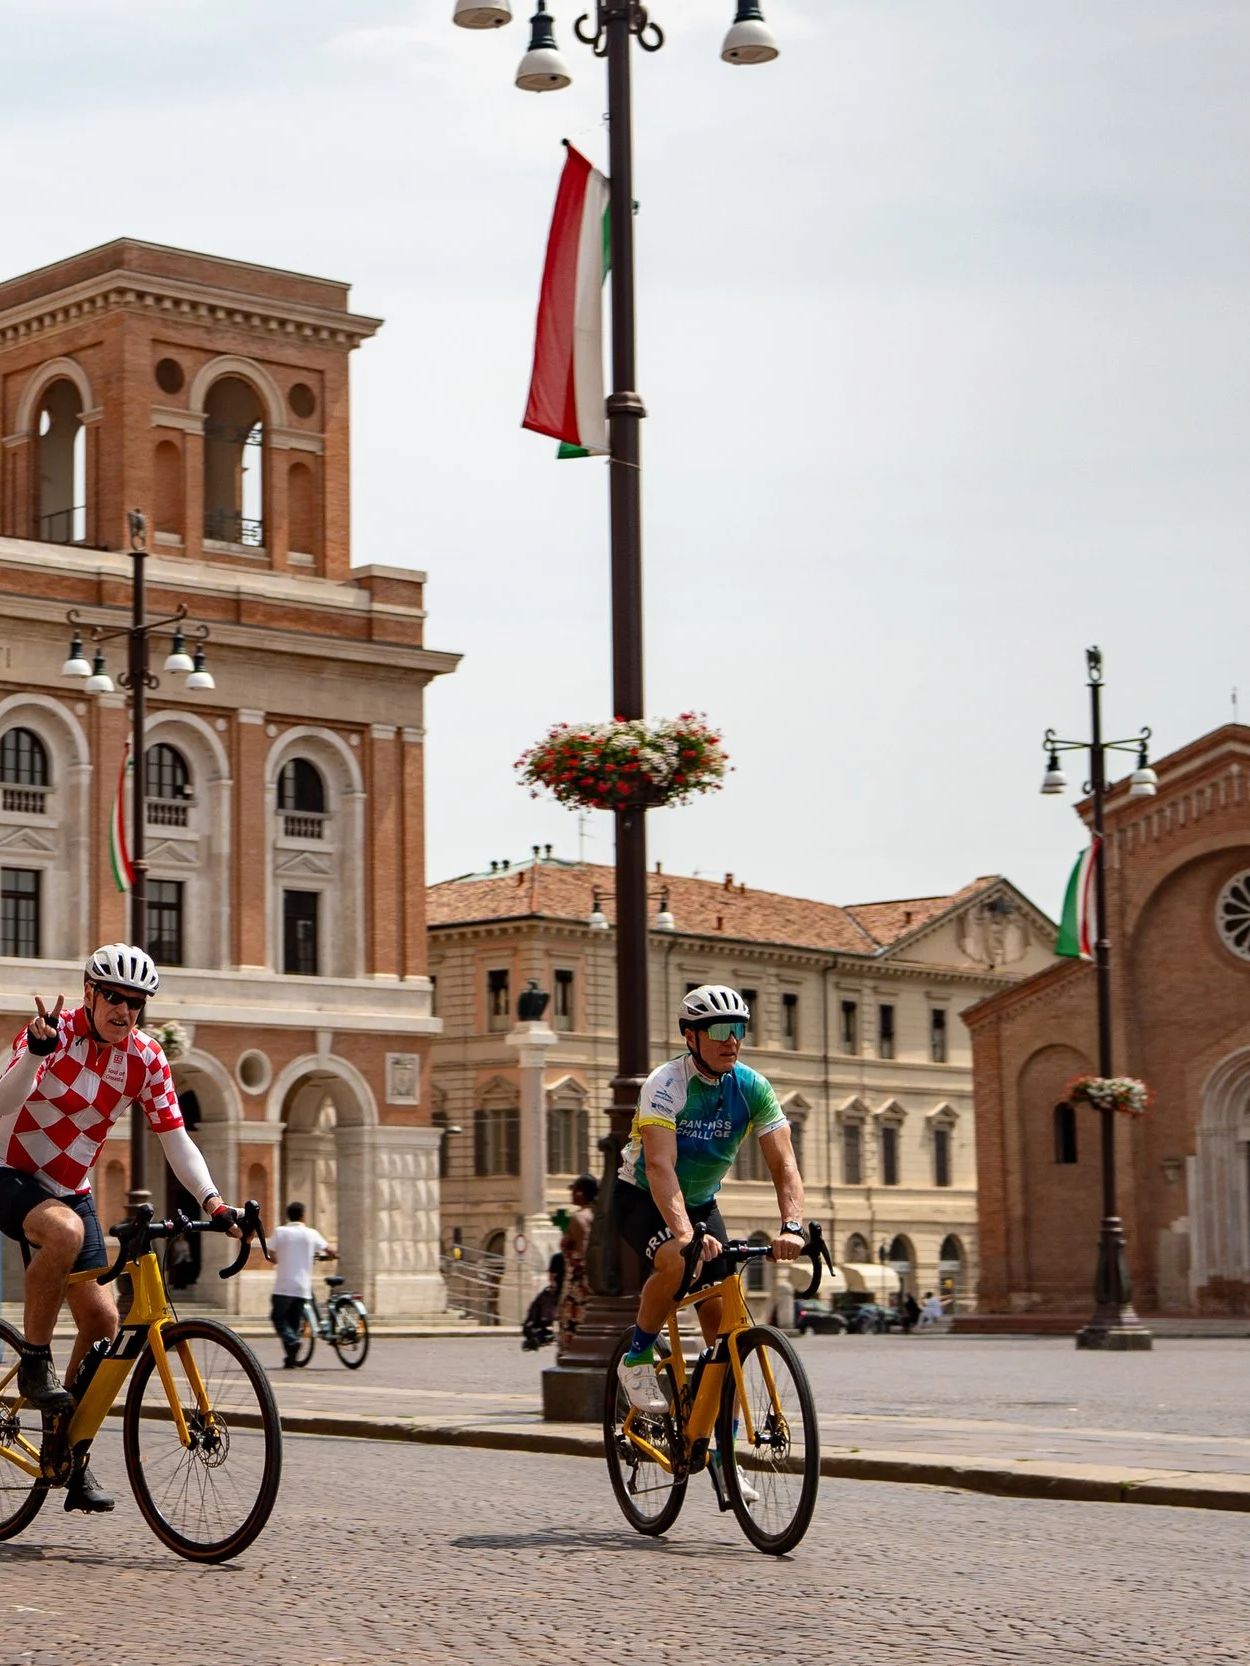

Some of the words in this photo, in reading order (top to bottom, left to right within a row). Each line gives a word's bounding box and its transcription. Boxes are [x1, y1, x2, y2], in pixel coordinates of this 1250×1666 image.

[679, 1119, 732, 1130] PAN-MSS
[676, 1127, 731, 1140] CHALLGE
[115, 1330, 137, 1355] T
